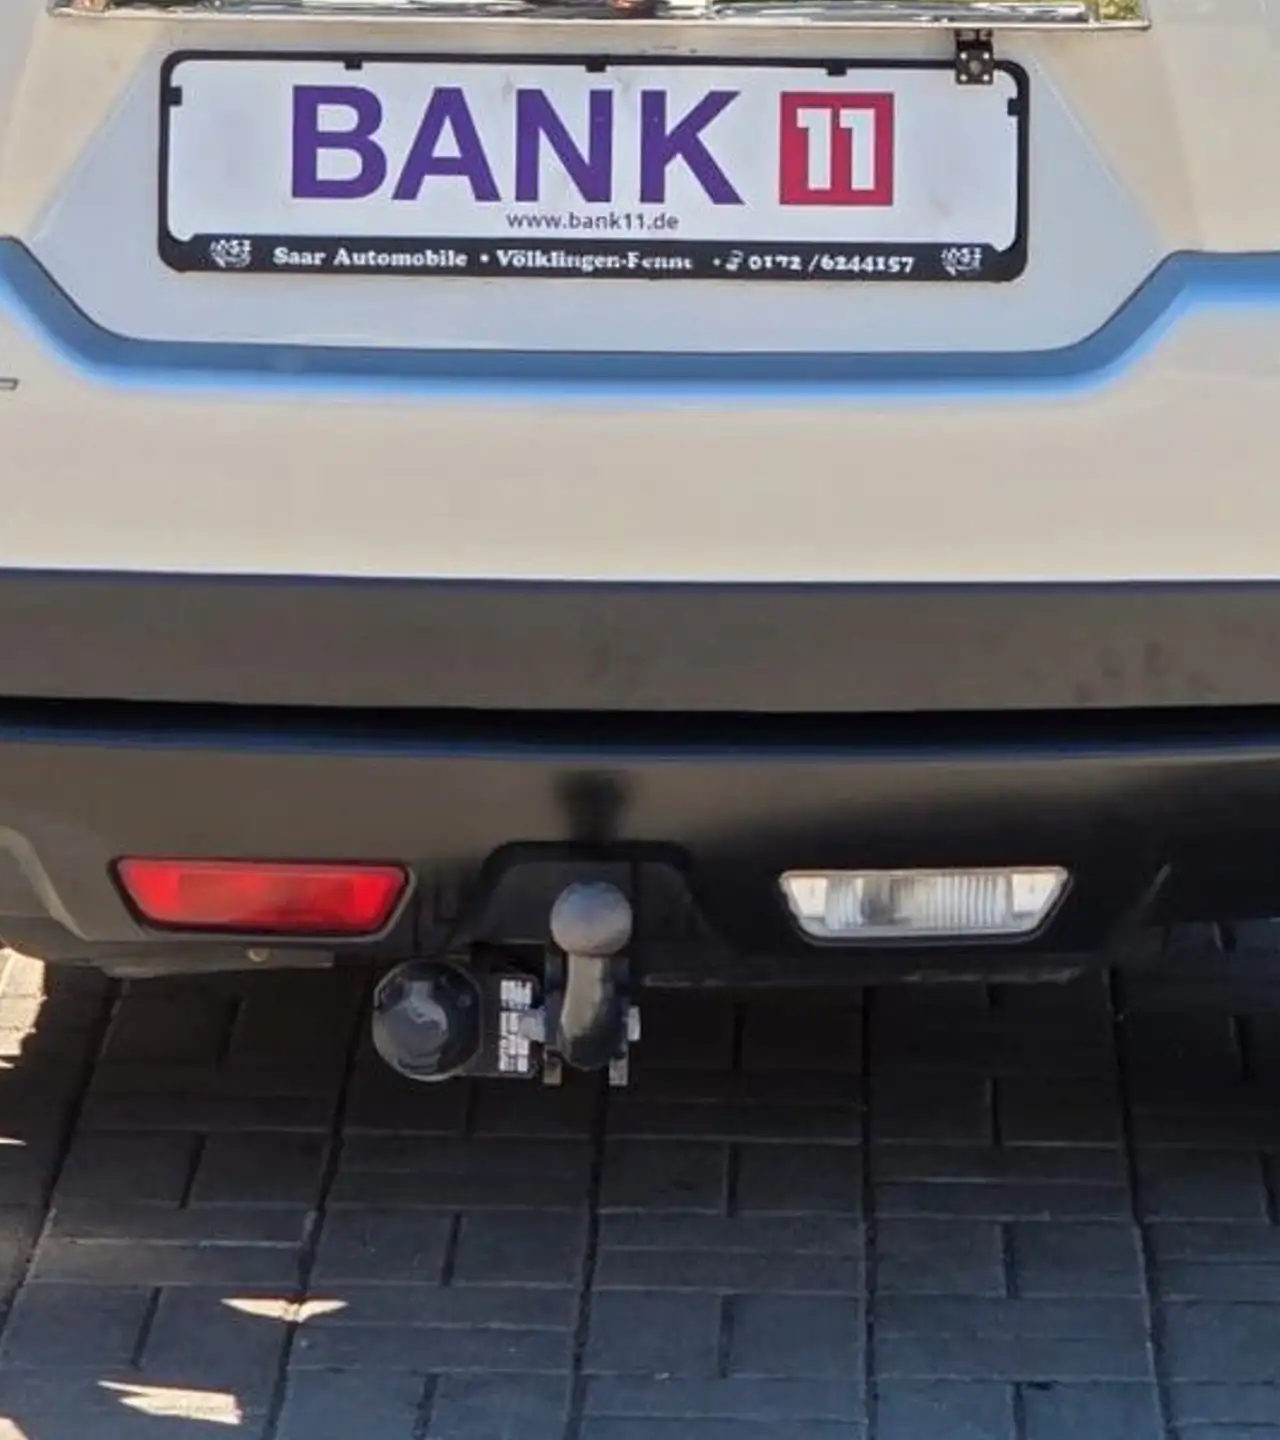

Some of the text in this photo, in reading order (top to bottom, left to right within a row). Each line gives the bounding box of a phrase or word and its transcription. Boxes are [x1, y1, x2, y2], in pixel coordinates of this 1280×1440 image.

[291, 84, 878, 205] BANK 11
[506, 212, 680, 231] www.bank11.de
[273, 246, 326, 266] Saar
[333, 247, 469, 268] Automobile
